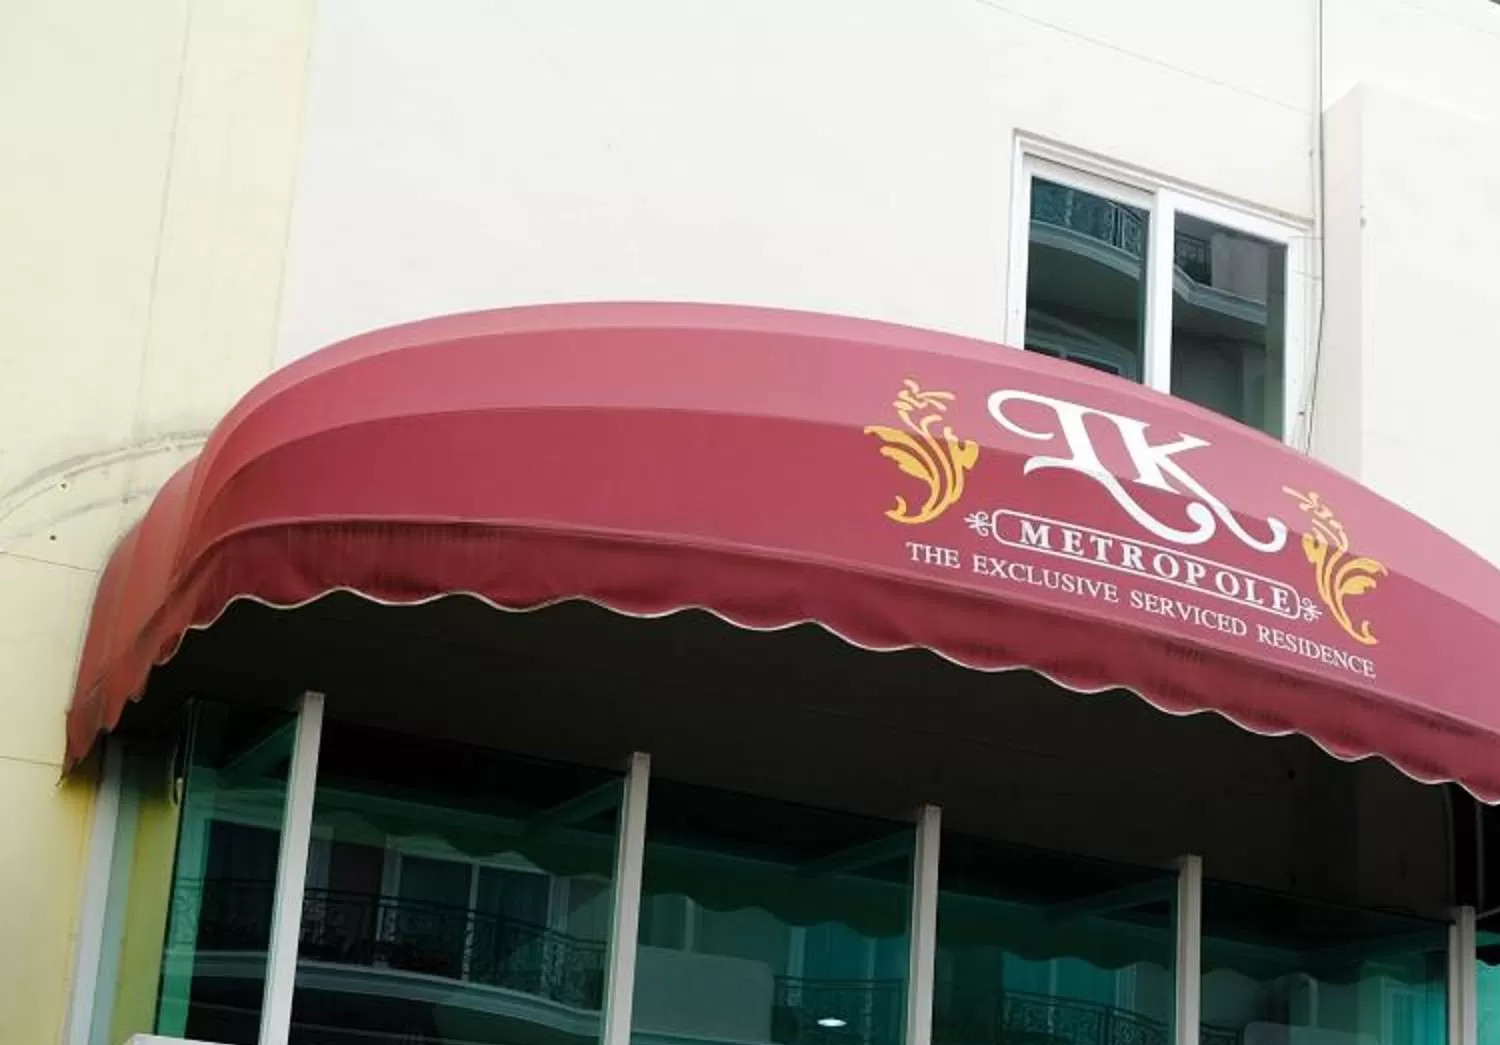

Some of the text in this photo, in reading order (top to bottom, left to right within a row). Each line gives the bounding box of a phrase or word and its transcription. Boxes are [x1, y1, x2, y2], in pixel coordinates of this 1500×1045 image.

[905, 541, 1377, 679] THE EXCLUSIVE SERVICED RESIDENCE
[1019, 519, 1291, 614] METROPOLE
